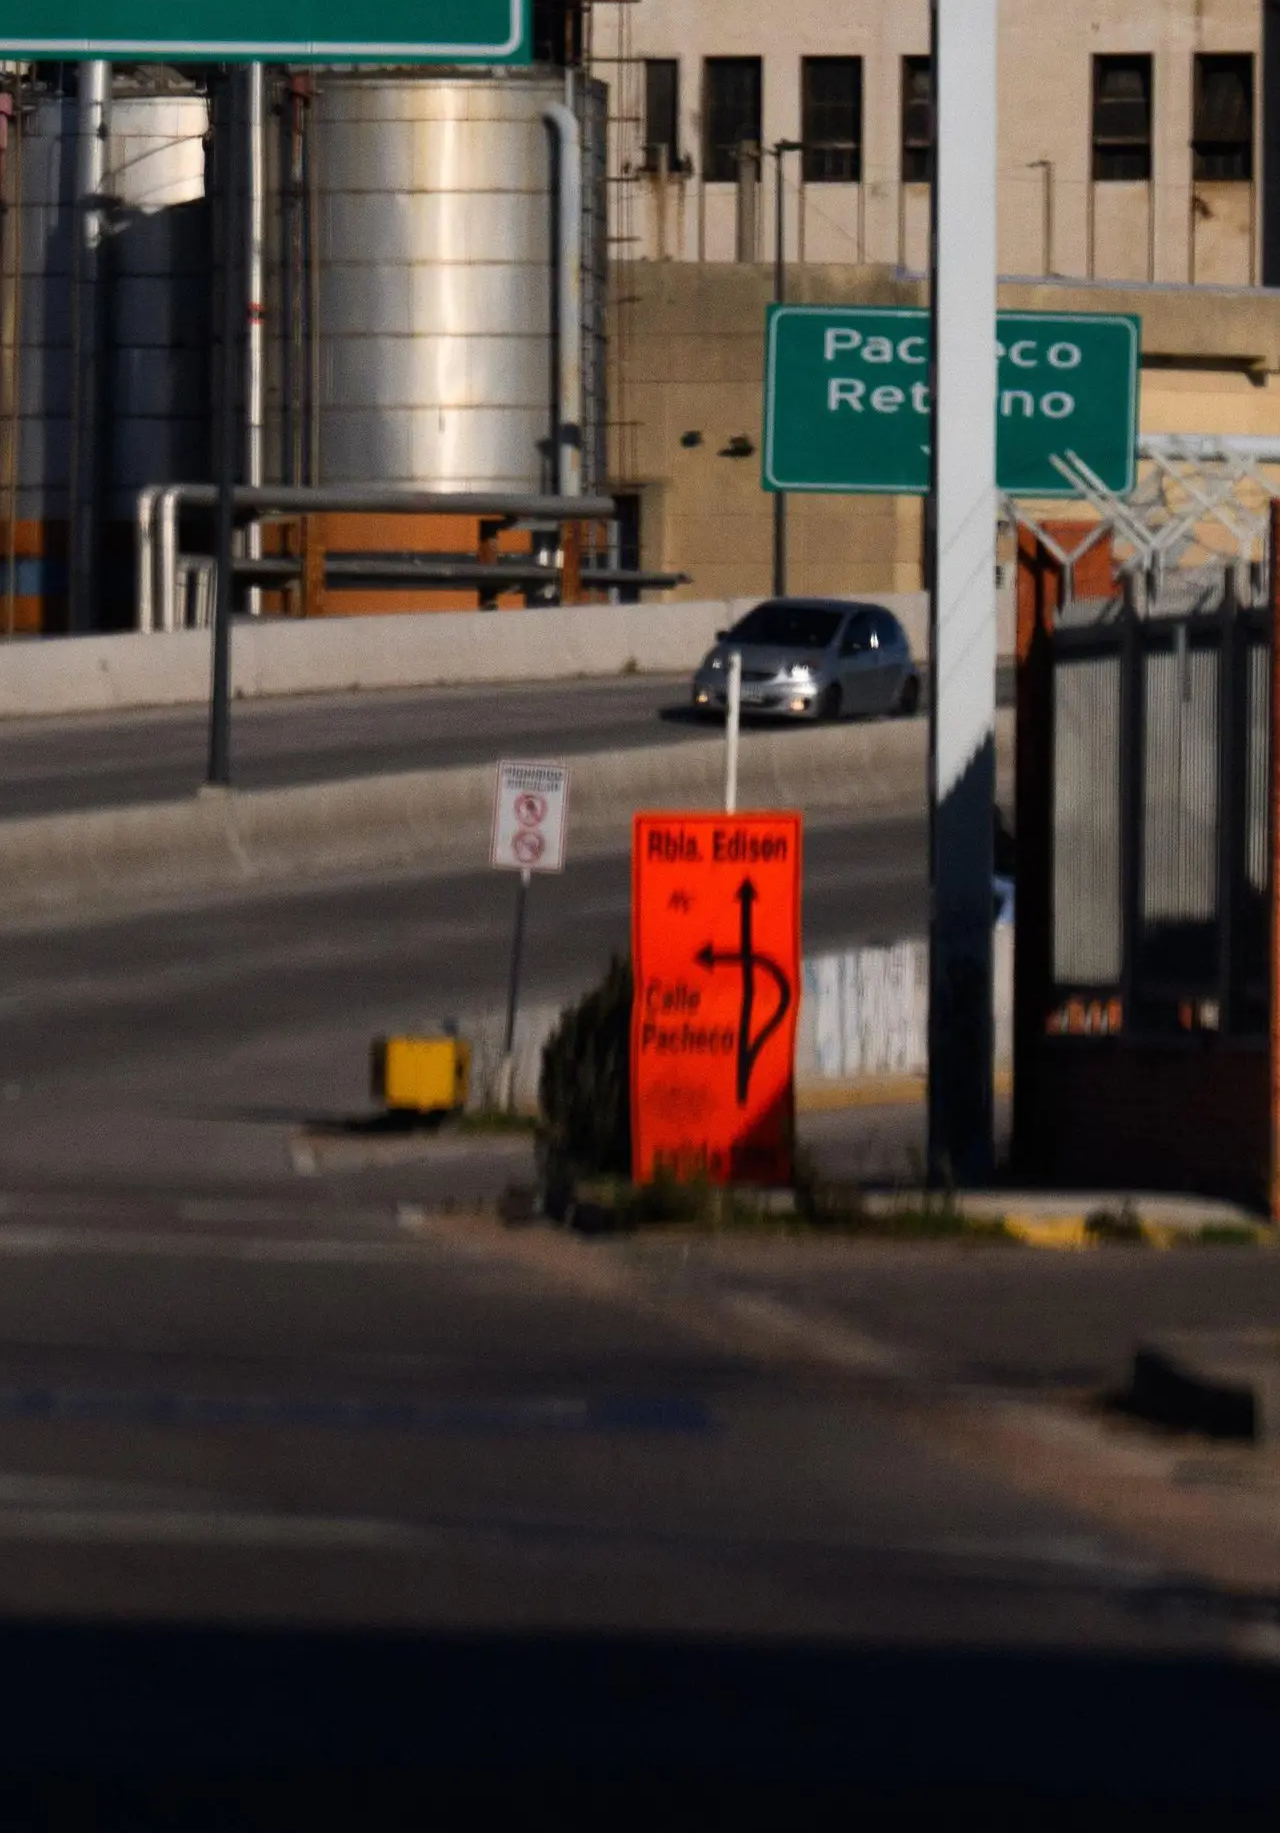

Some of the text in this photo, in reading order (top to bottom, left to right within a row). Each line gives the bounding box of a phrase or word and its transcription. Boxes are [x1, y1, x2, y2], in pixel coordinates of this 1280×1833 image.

[823, 327, 1082, 369] Pacco
[827, 377, 1076, 419] Retno
[711, 828, 788, 863] Edison
[641, 1021, 735, 1054] Pacheco
